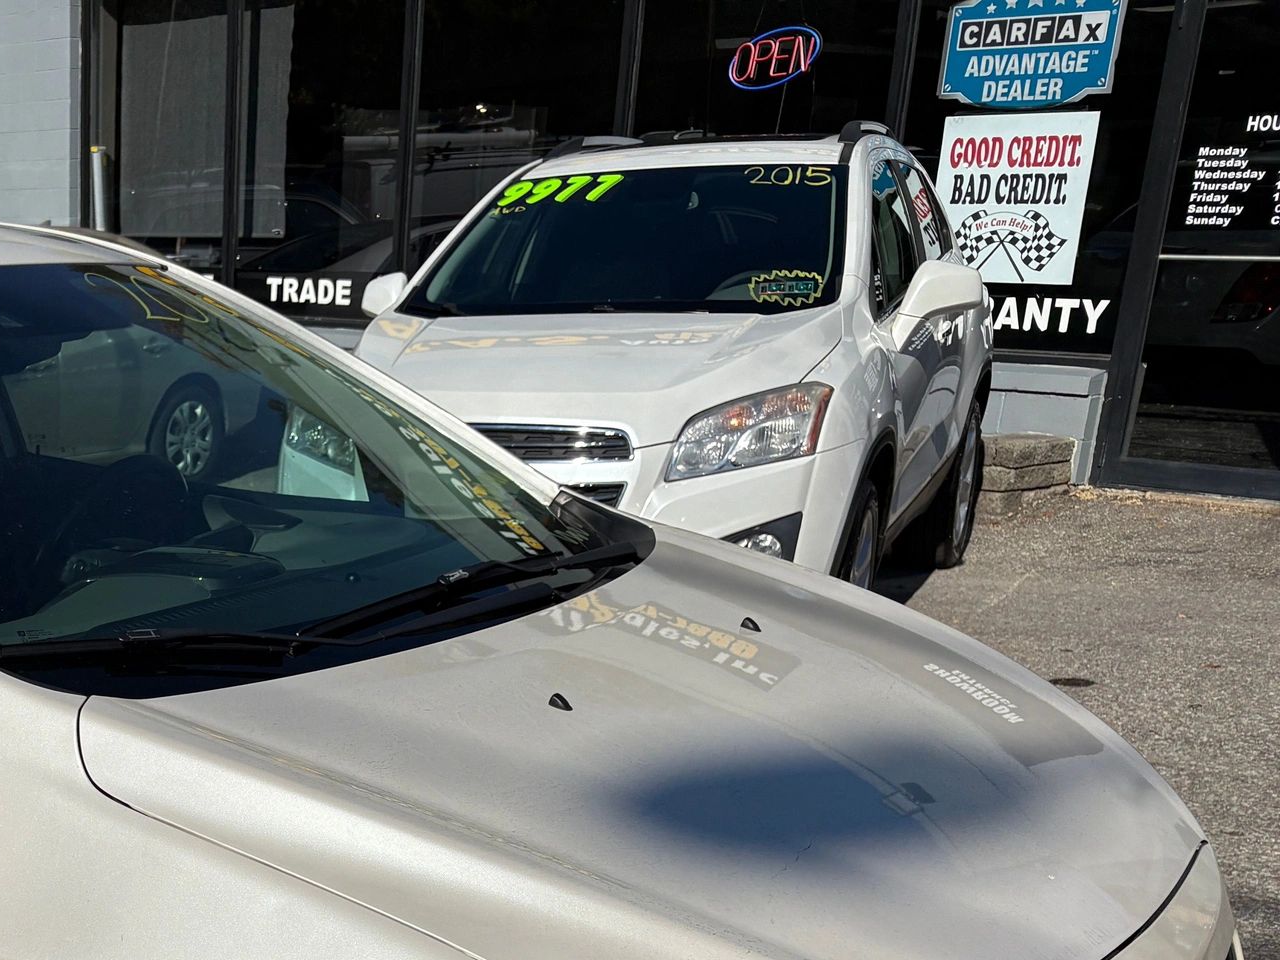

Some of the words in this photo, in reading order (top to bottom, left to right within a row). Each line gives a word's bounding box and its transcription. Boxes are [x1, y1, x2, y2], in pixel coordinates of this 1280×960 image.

[963, 19, 1104, 46] CARFAX
[732, 35, 816, 82] OPEN
[964, 50, 1091, 77] ADVANTAGE
[981, 78, 1064, 102] DEALER
[950, 137, 1004, 169] GOOD
[1007, 134, 1082, 168] CREDIT.
[1198, 146, 1248, 157] Monday
[1194, 169, 1266, 180] Wednesday
[1197, 158, 1249, 169] Tuesday
[744, 166, 832, 186] 2015
[1192, 181, 1251, 192] Thursday
[497, 174, 625, 206] 9977
[950, 173, 991, 205] BAD
[995, 172, 1068, 205] CREDIT.
[1189, 193, 1229, 204] Friday
[1185, 215, 1231, 227] Sunday
[1187, 204, 1244, 216] Saturday
[975, 221, 988, 232] We
[990, 218, 1007, 227] Can
[1008, 217, 1033, 233] Help!
[266, 276, 352, 306] TRADE
[990, 296, 1111, 334] ANTY
